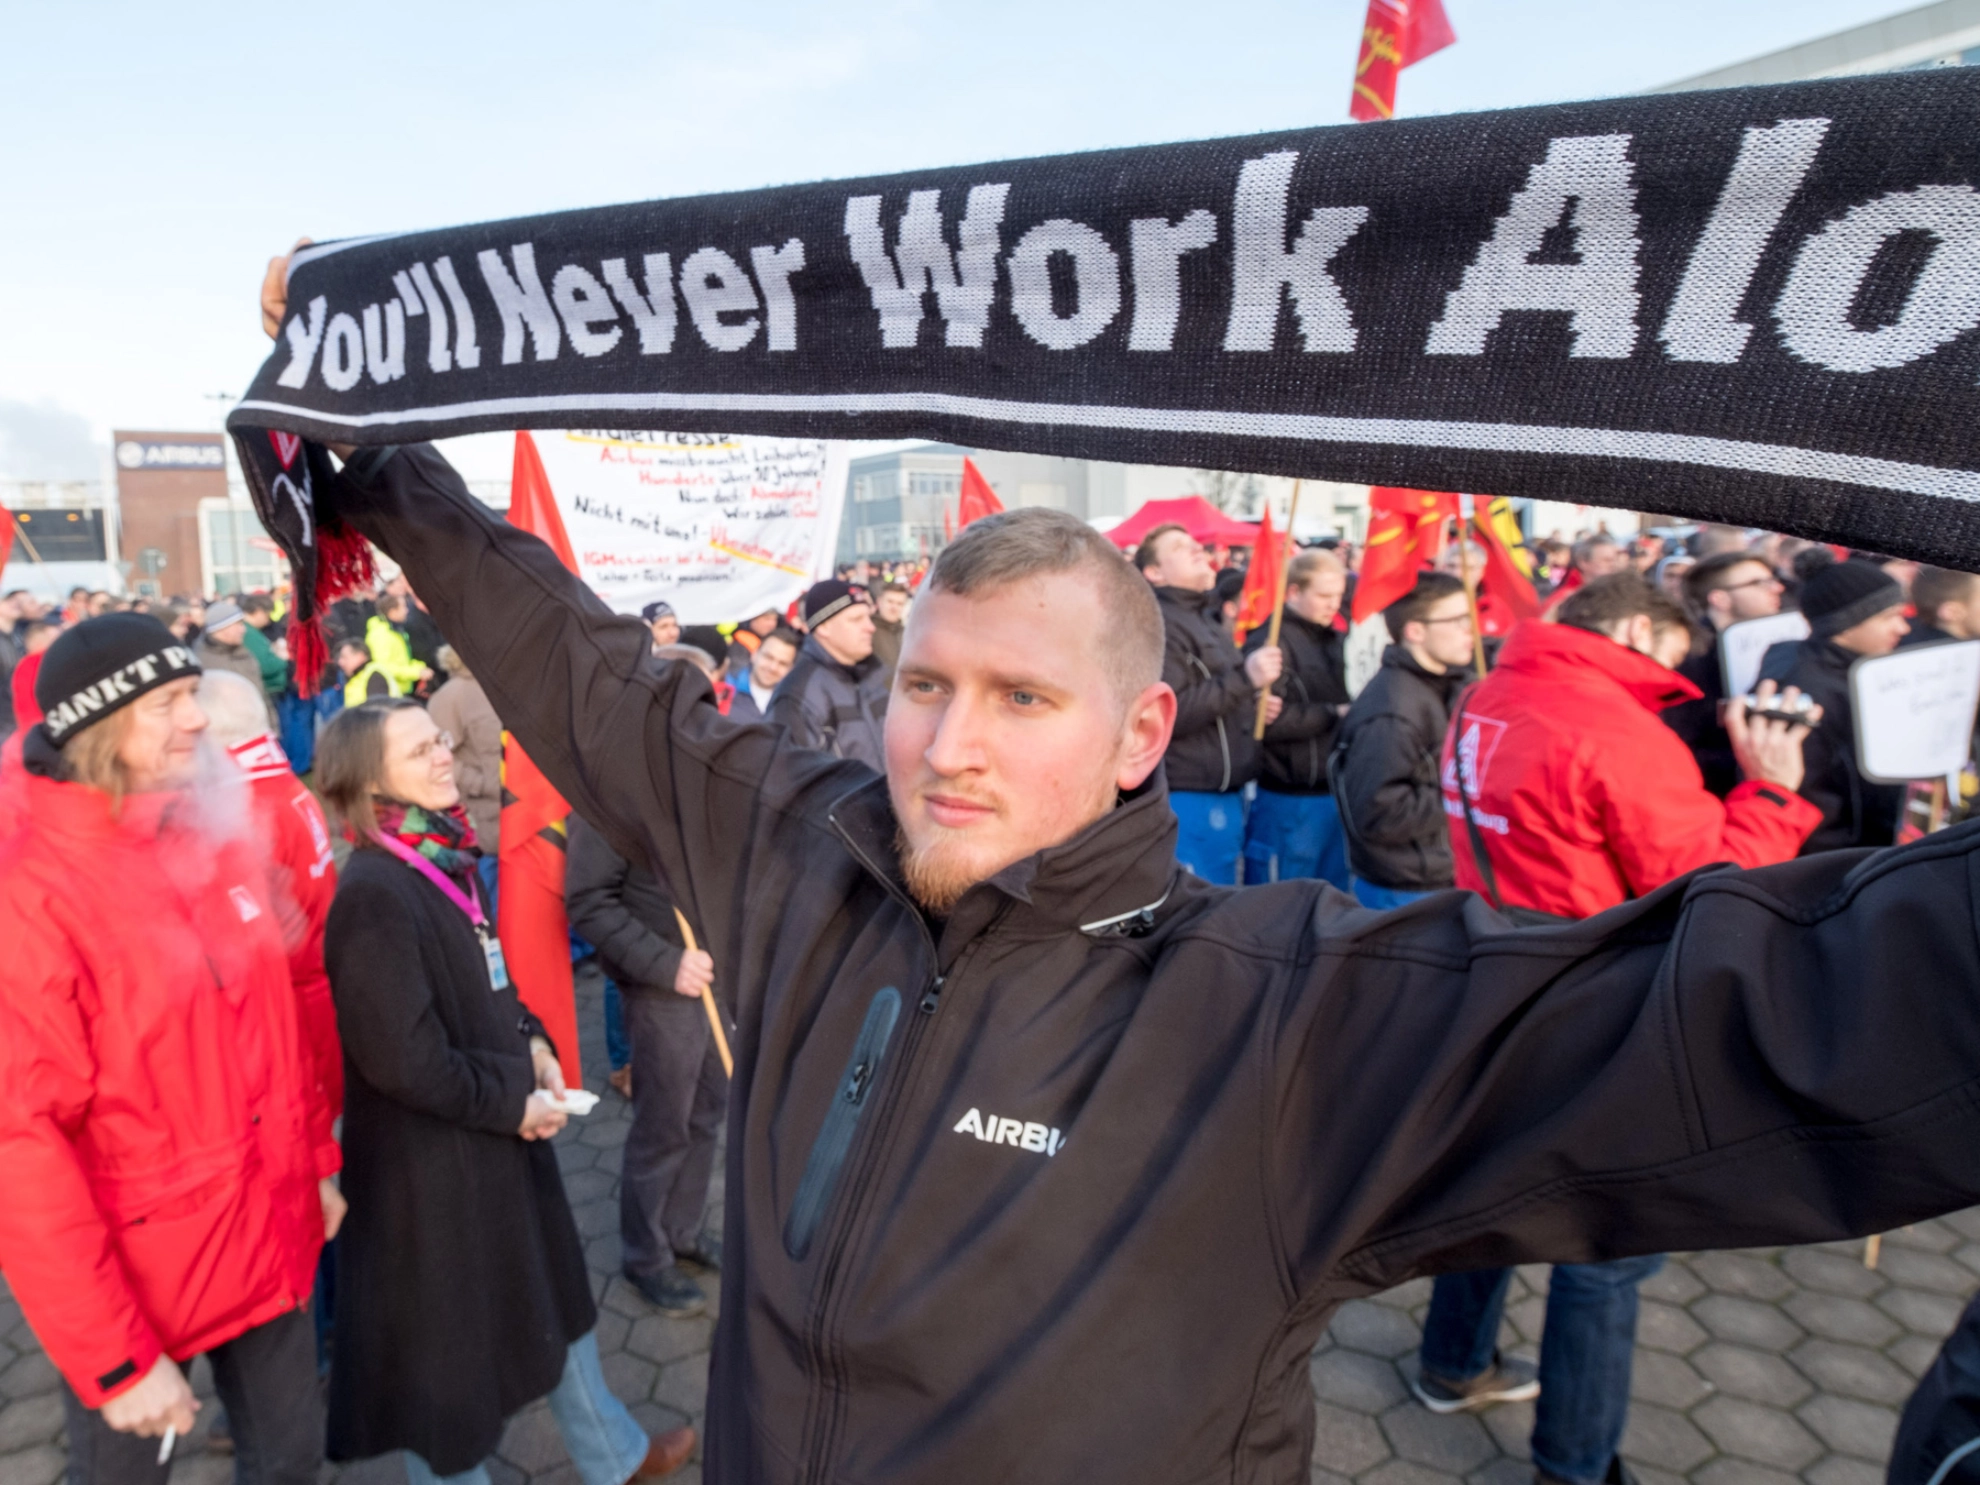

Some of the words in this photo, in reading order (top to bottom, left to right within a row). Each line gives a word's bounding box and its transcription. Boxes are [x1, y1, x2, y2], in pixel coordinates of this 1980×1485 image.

[276, 255, 481, 393] You'll
[477, 237, 806, 366] Never
[844, 150, 1369, 353] Work
[1424, 117, 1980, 373] Alo
[146, 446, 224, 464] AIRBUS
[575, 495, 622, 523] Nicht
[630, 512, 660, 535] mit
[46, 653, 159, 738] SANKT
